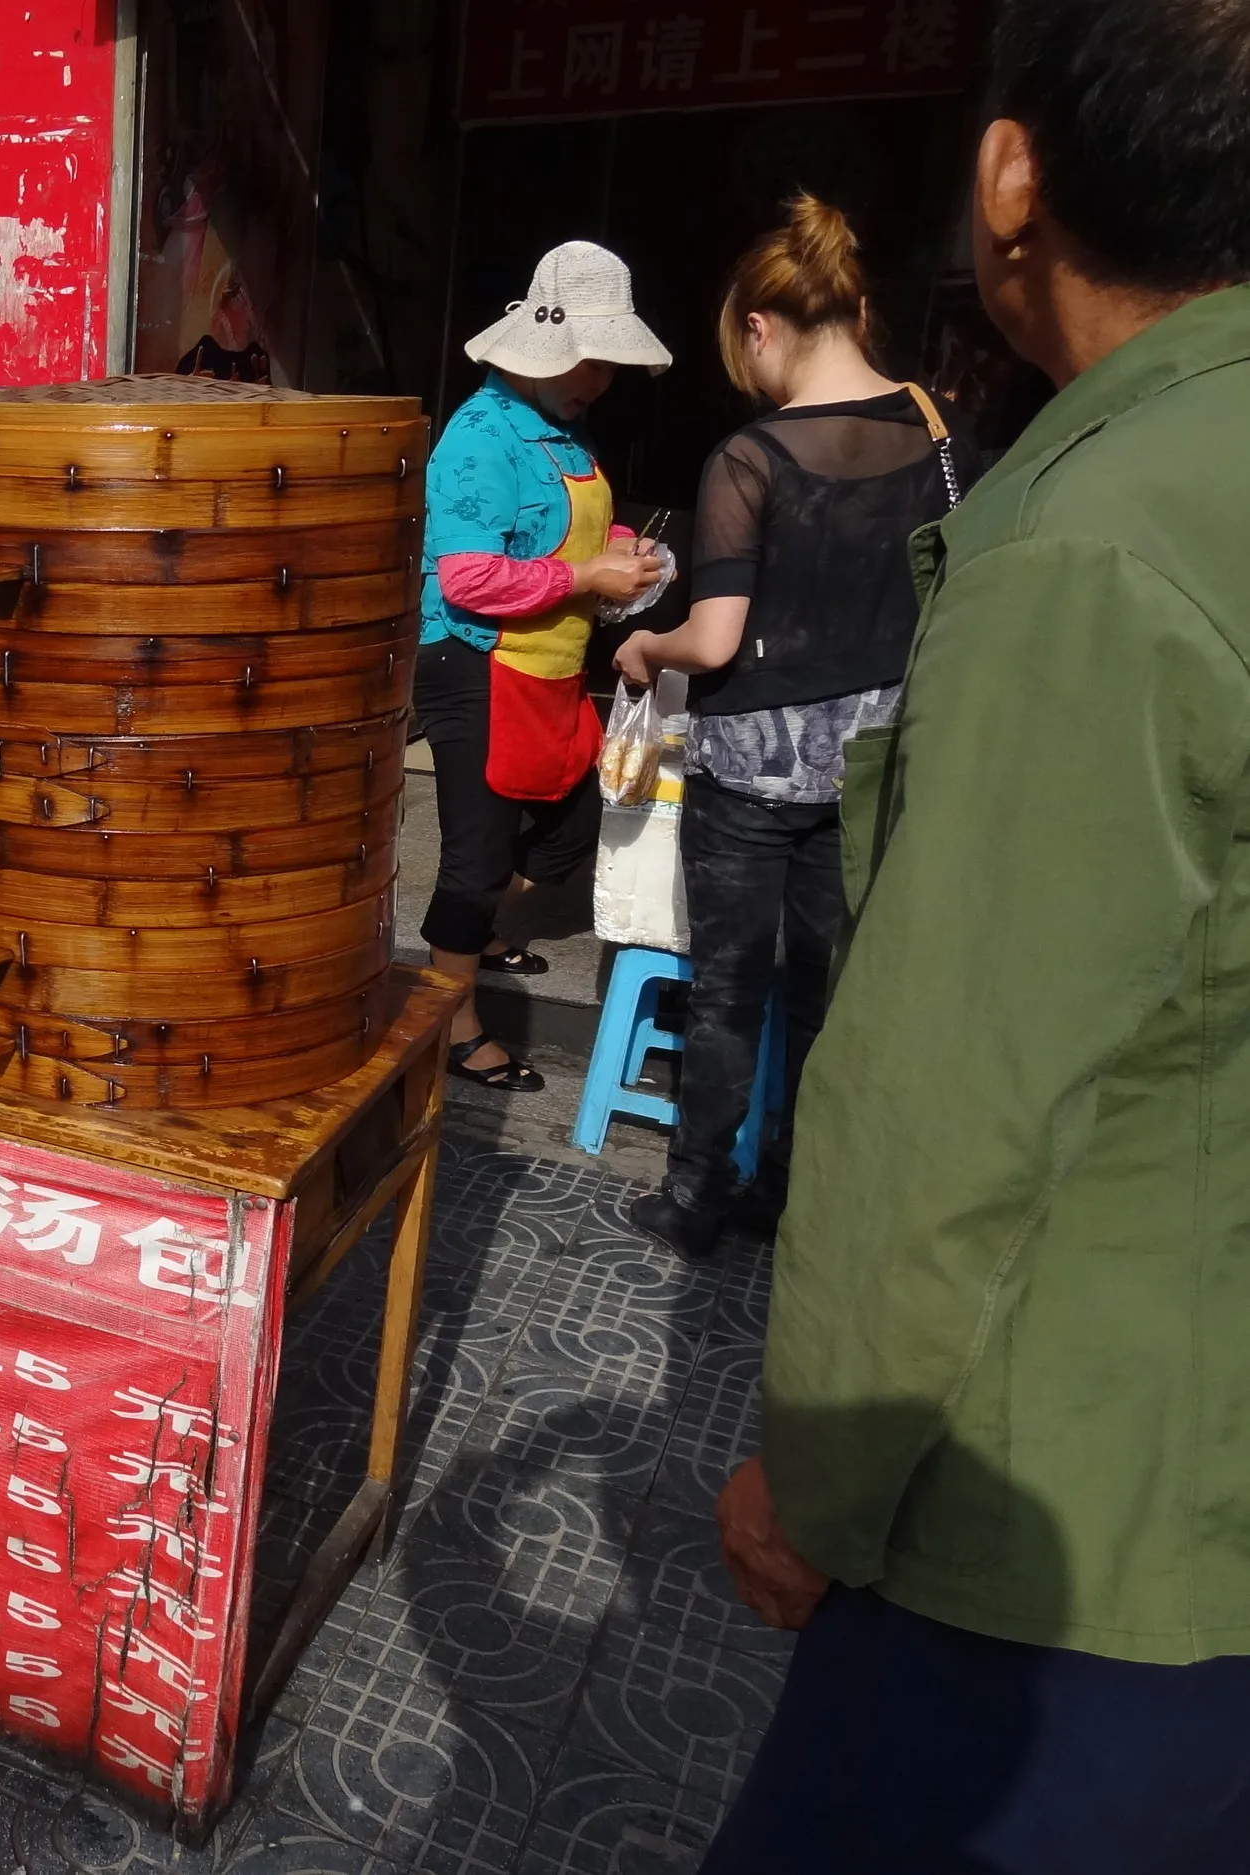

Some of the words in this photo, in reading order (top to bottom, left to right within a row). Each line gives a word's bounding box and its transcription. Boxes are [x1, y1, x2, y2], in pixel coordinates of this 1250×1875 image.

[486, 1, 958, 102] 上网请上二楼
[110, 1386, 236, 1448] 元
[107, 1451, 229, 1514] 元
[106, 1513, 224, 1578] 元
[106, 1567, 216, 1640] 元
[106, 1625, 209, 1701] 元
